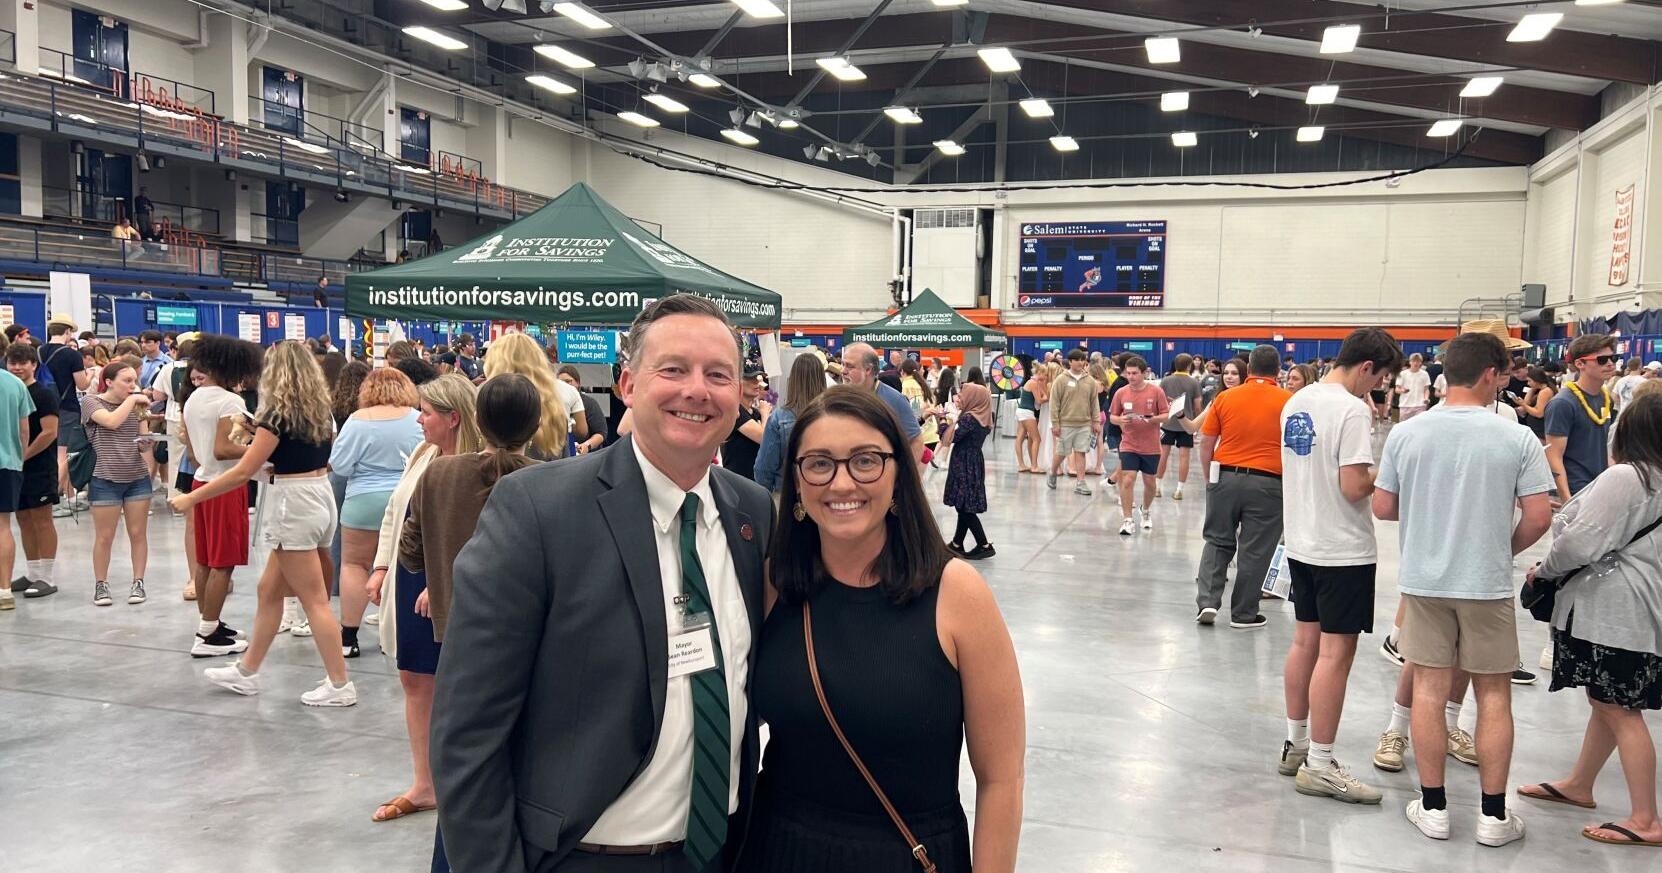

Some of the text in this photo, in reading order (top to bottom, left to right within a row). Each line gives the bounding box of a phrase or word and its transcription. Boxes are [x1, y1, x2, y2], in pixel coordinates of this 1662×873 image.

[1034, 224, 1064, 234] Salem
[504, 238, 615, 248] INSTITUTION
[496, 246, 606, 257] FOR SAVINGS
[368, 286, 638, 312] institutionforsavings.com
[1031, 297, 1052, 305] pepsi
[270, 314, 276, 326] 3
[566, 333, 575, 341] Hi,
[853, 333, 972, 344] institutionforsavings.com
[566, 351, 593, 359] purr-fect
[676, 641, 692, 649] Mayor
[681, 647, 703, 656] Reardon
